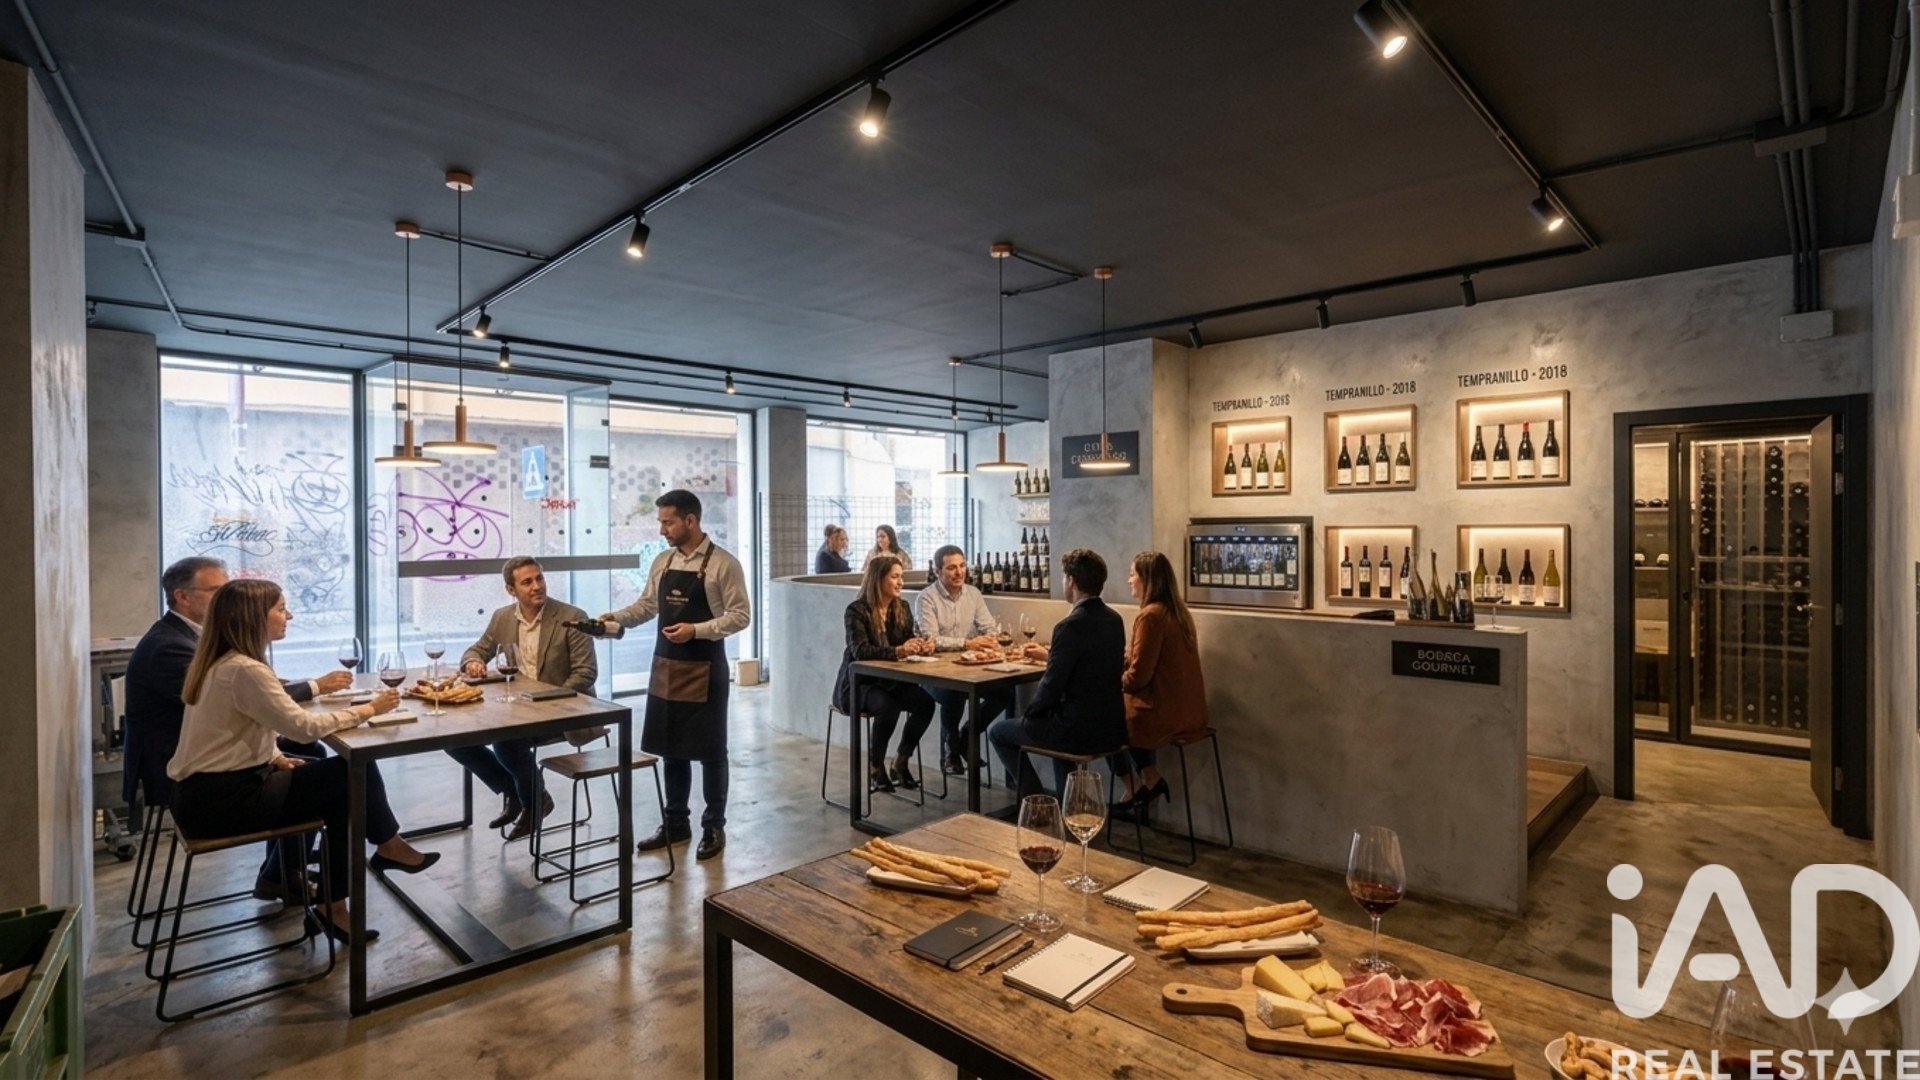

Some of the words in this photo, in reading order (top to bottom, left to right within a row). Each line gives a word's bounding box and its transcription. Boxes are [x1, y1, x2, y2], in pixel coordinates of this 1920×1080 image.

[1458, 369, 1529, 387] TEMPRANILLO
[1539, 364, 1568, 380] 2018
[1325, 384, 1385, 401] TEMPRANILLO
[1392, 381, 1417, 395] 2018
